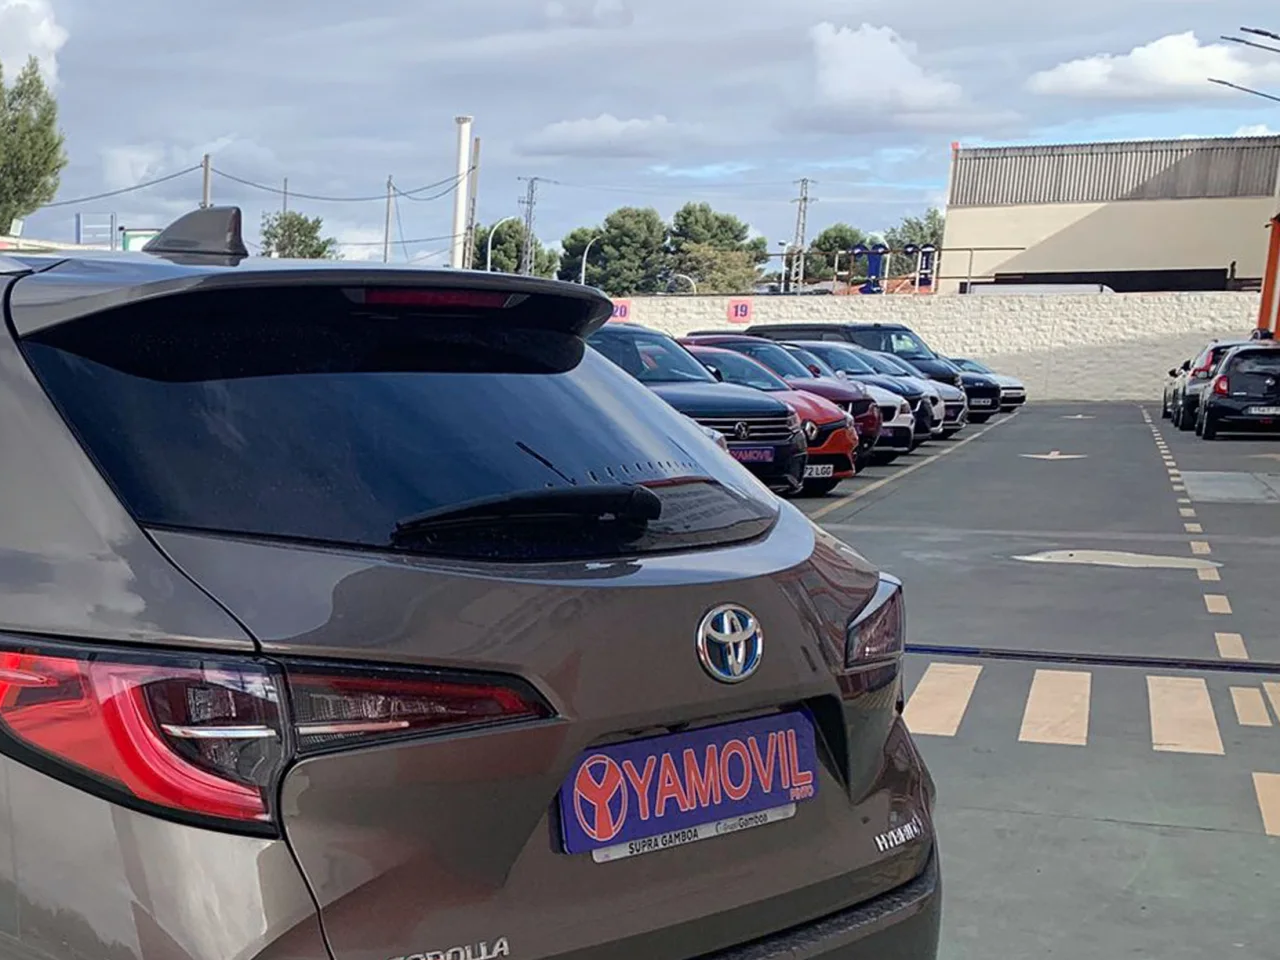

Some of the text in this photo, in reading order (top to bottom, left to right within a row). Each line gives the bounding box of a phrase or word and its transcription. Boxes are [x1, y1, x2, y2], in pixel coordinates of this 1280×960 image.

[733, 303, 748, 318] 19
[622, 728, 814, 822] YAMOVIL
[628, 828, 699, 855] SUPRA GAMBOA
